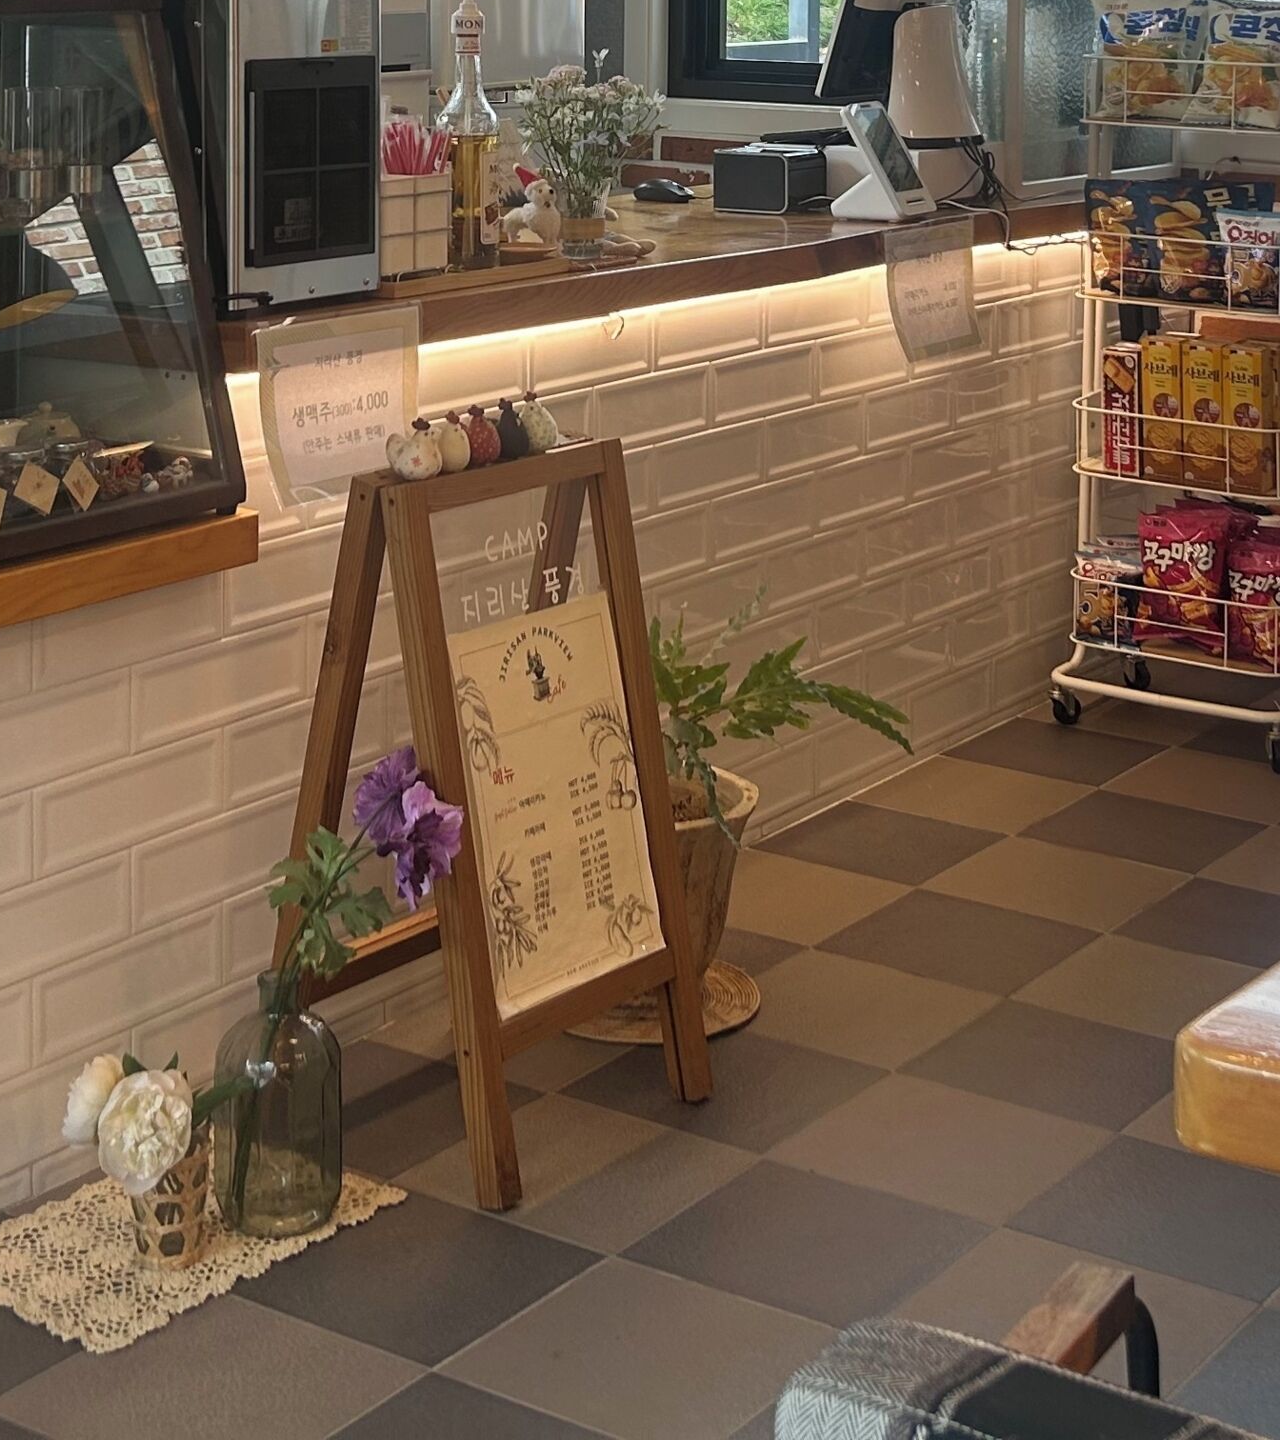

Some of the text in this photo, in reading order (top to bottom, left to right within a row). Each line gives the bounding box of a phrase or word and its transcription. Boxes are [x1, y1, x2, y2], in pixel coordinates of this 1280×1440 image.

[1143, 361, 1178, 379] 사브레
[1184, 366, 1220, 383] 사브레
[1224, 371, 1260, 388] 사브레
[484, 521, 548, 562] CAMP
[1143, 539, 1216, 572] 고구마깡
[460, 563, 584, 623] 지리산 풍경
[499, 626, 574, 683] JIRISAN PARKVIEW
[493, 766, 515, 785] 메뉴
